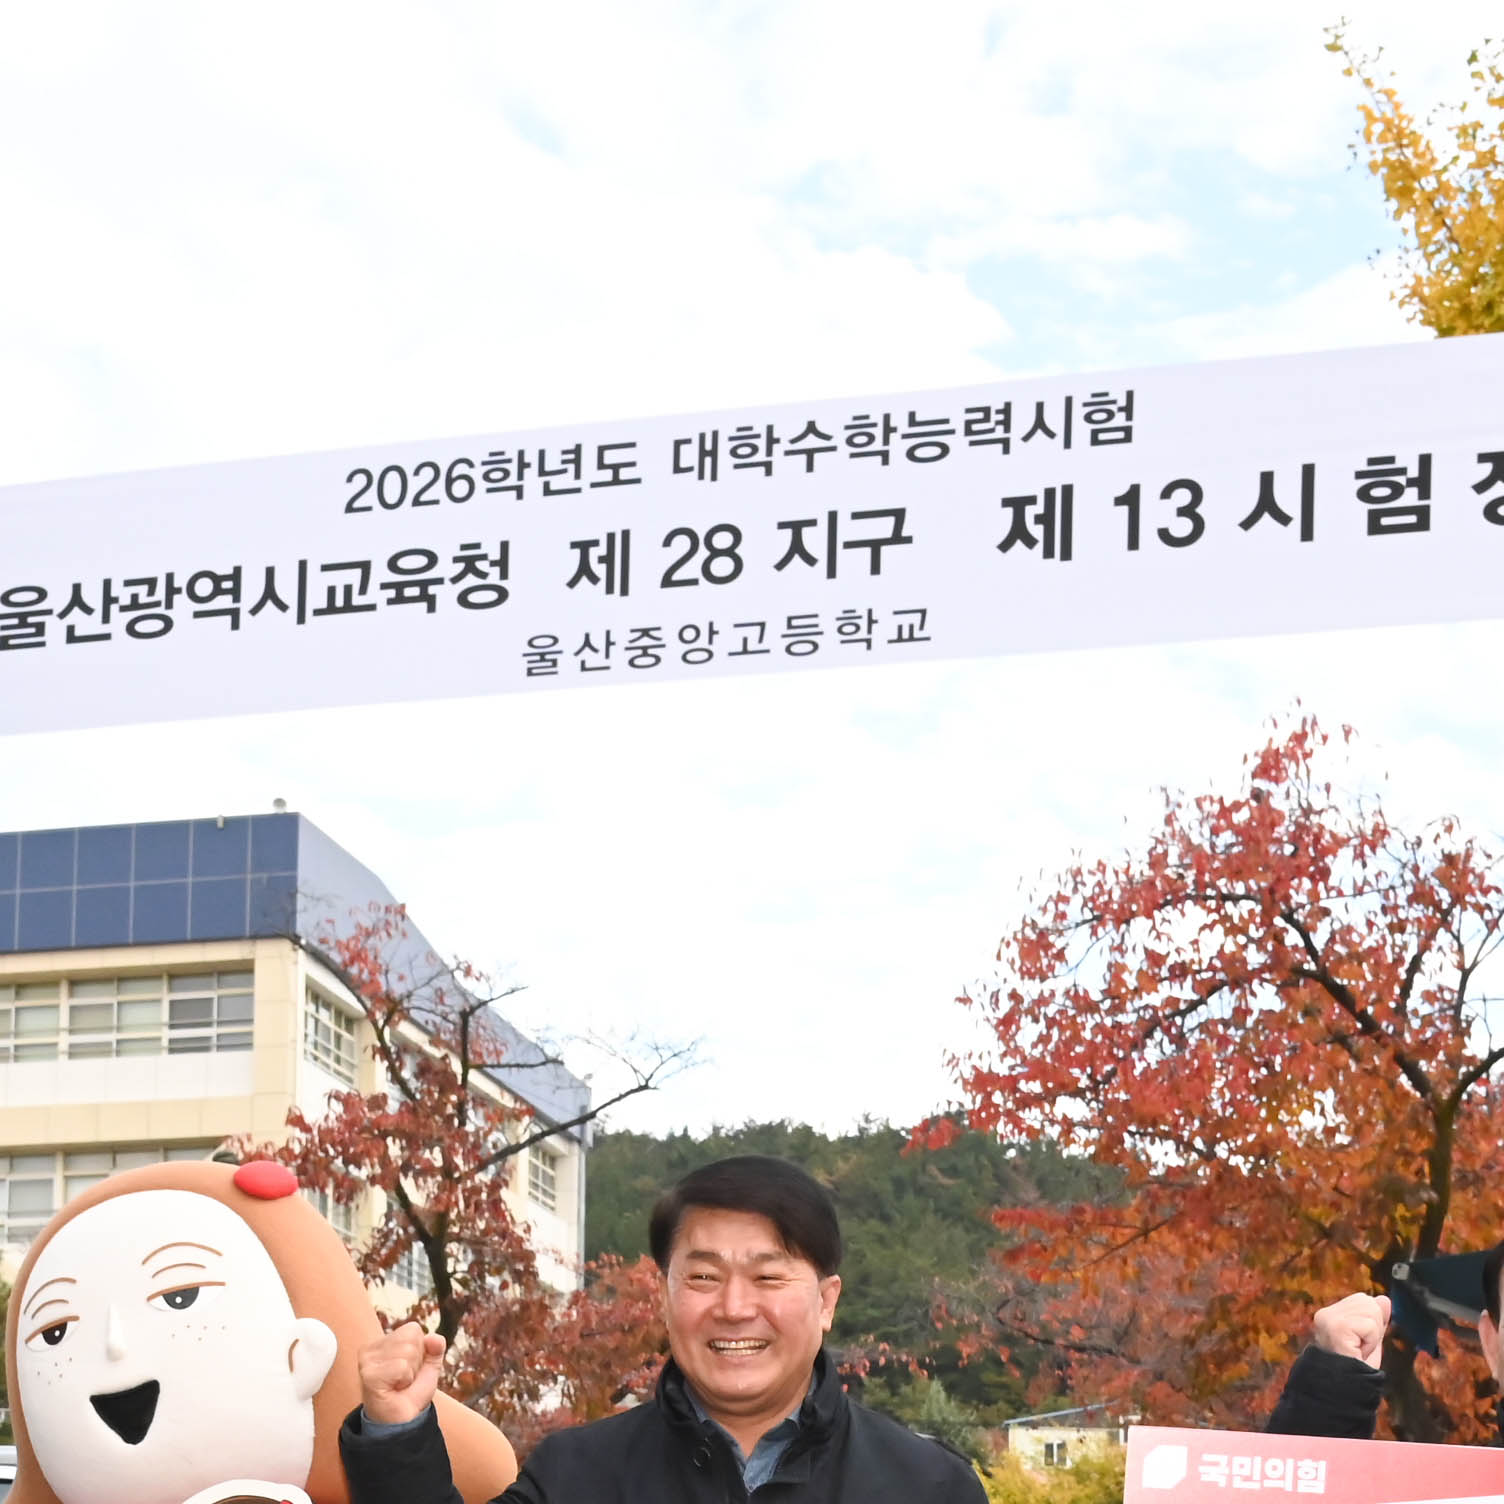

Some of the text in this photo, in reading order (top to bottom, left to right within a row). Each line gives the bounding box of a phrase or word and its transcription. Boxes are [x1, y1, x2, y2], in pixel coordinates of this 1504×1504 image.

[345, 390, 1133, 513] 2026학년도 대학수학능력시험
[566, 530, 630, 596] 제
[661, 524, 743, 588] 28
[774, 508, 912, 579] 지구
[997, 484, 1073, 561] 제
[1114, 479, 1204, 550] 13
[523, 609, 930, 676] 울산중앙고등학교
[1197, 1452, 1329, 1494] 국민의힘
